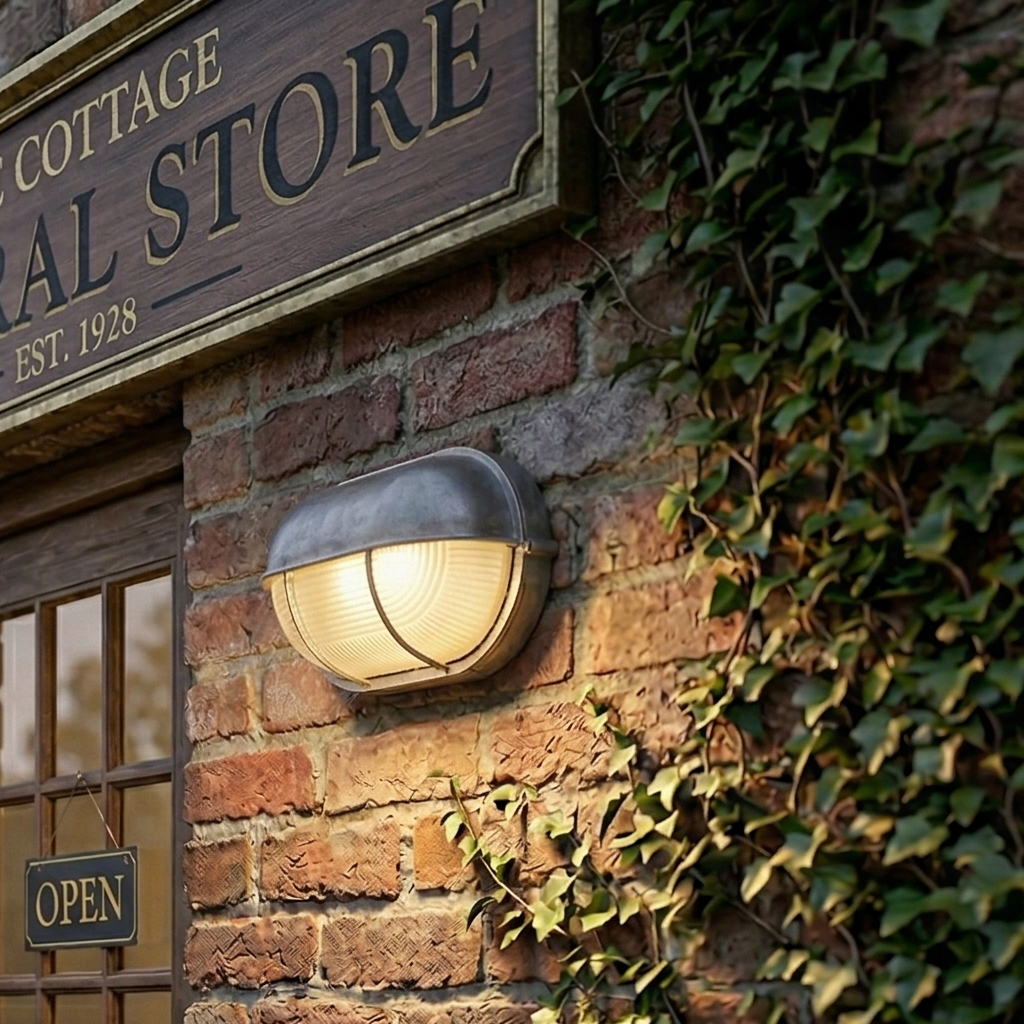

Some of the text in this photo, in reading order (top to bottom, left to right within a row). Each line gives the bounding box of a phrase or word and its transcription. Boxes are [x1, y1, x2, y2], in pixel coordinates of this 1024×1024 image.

[14, 28, 222, 193] COTTAGE
[145, 0, 494, 266] STORE
[15, 297, 137, 384] EST. 1928
[36, 875, 124, 927] OPEN
